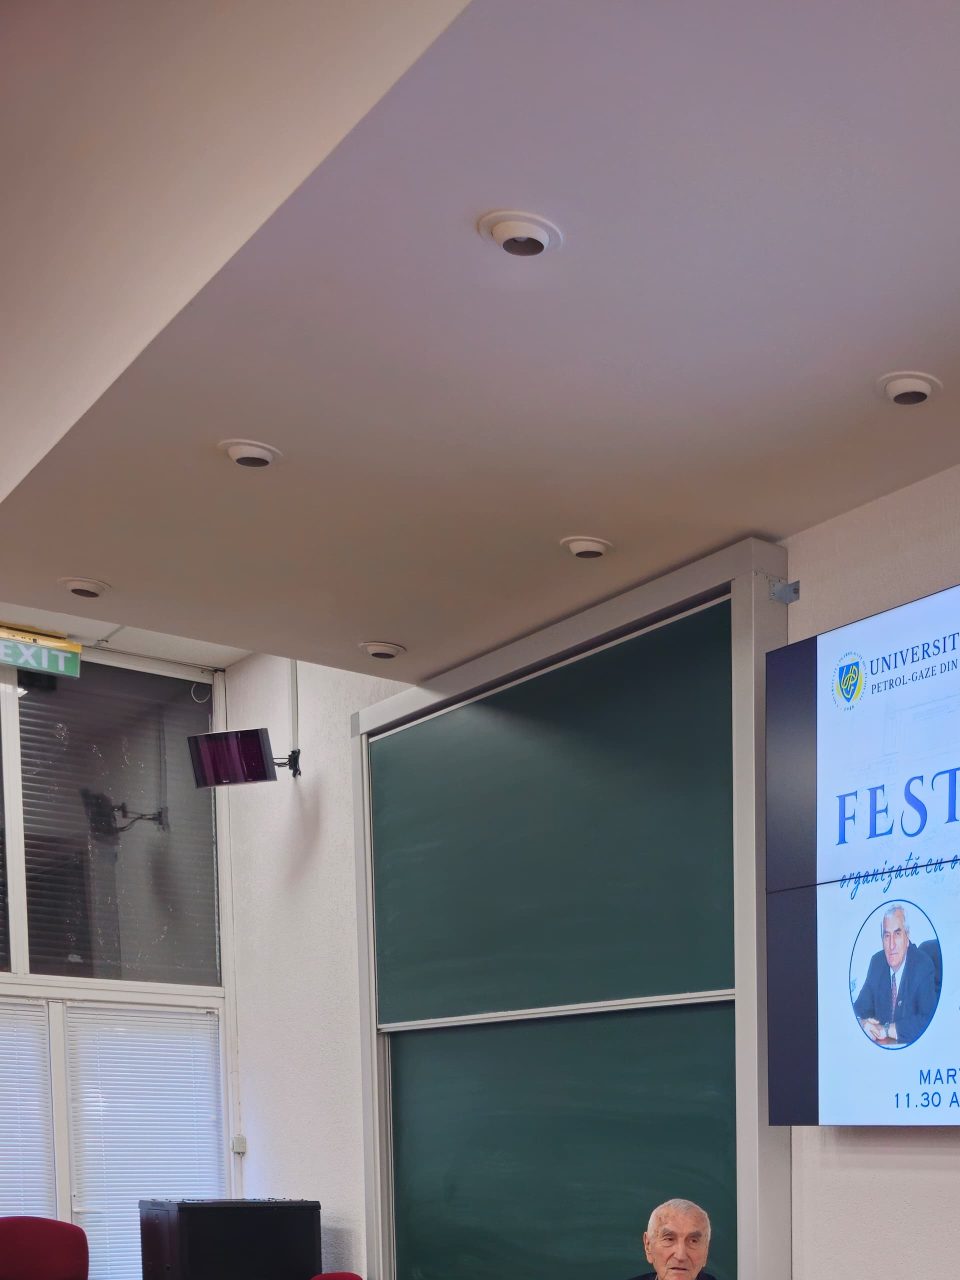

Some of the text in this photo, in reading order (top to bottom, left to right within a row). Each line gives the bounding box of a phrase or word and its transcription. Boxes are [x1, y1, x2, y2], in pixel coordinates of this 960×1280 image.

[0, 641, 72, 671] EXIT
[871, 665, 937, 694] PETROL-GAZE
[940, 659, 958, 673] DIN
[925, 858, 944, 873] cu
[895, 1091, 942, 1108] 11.30
